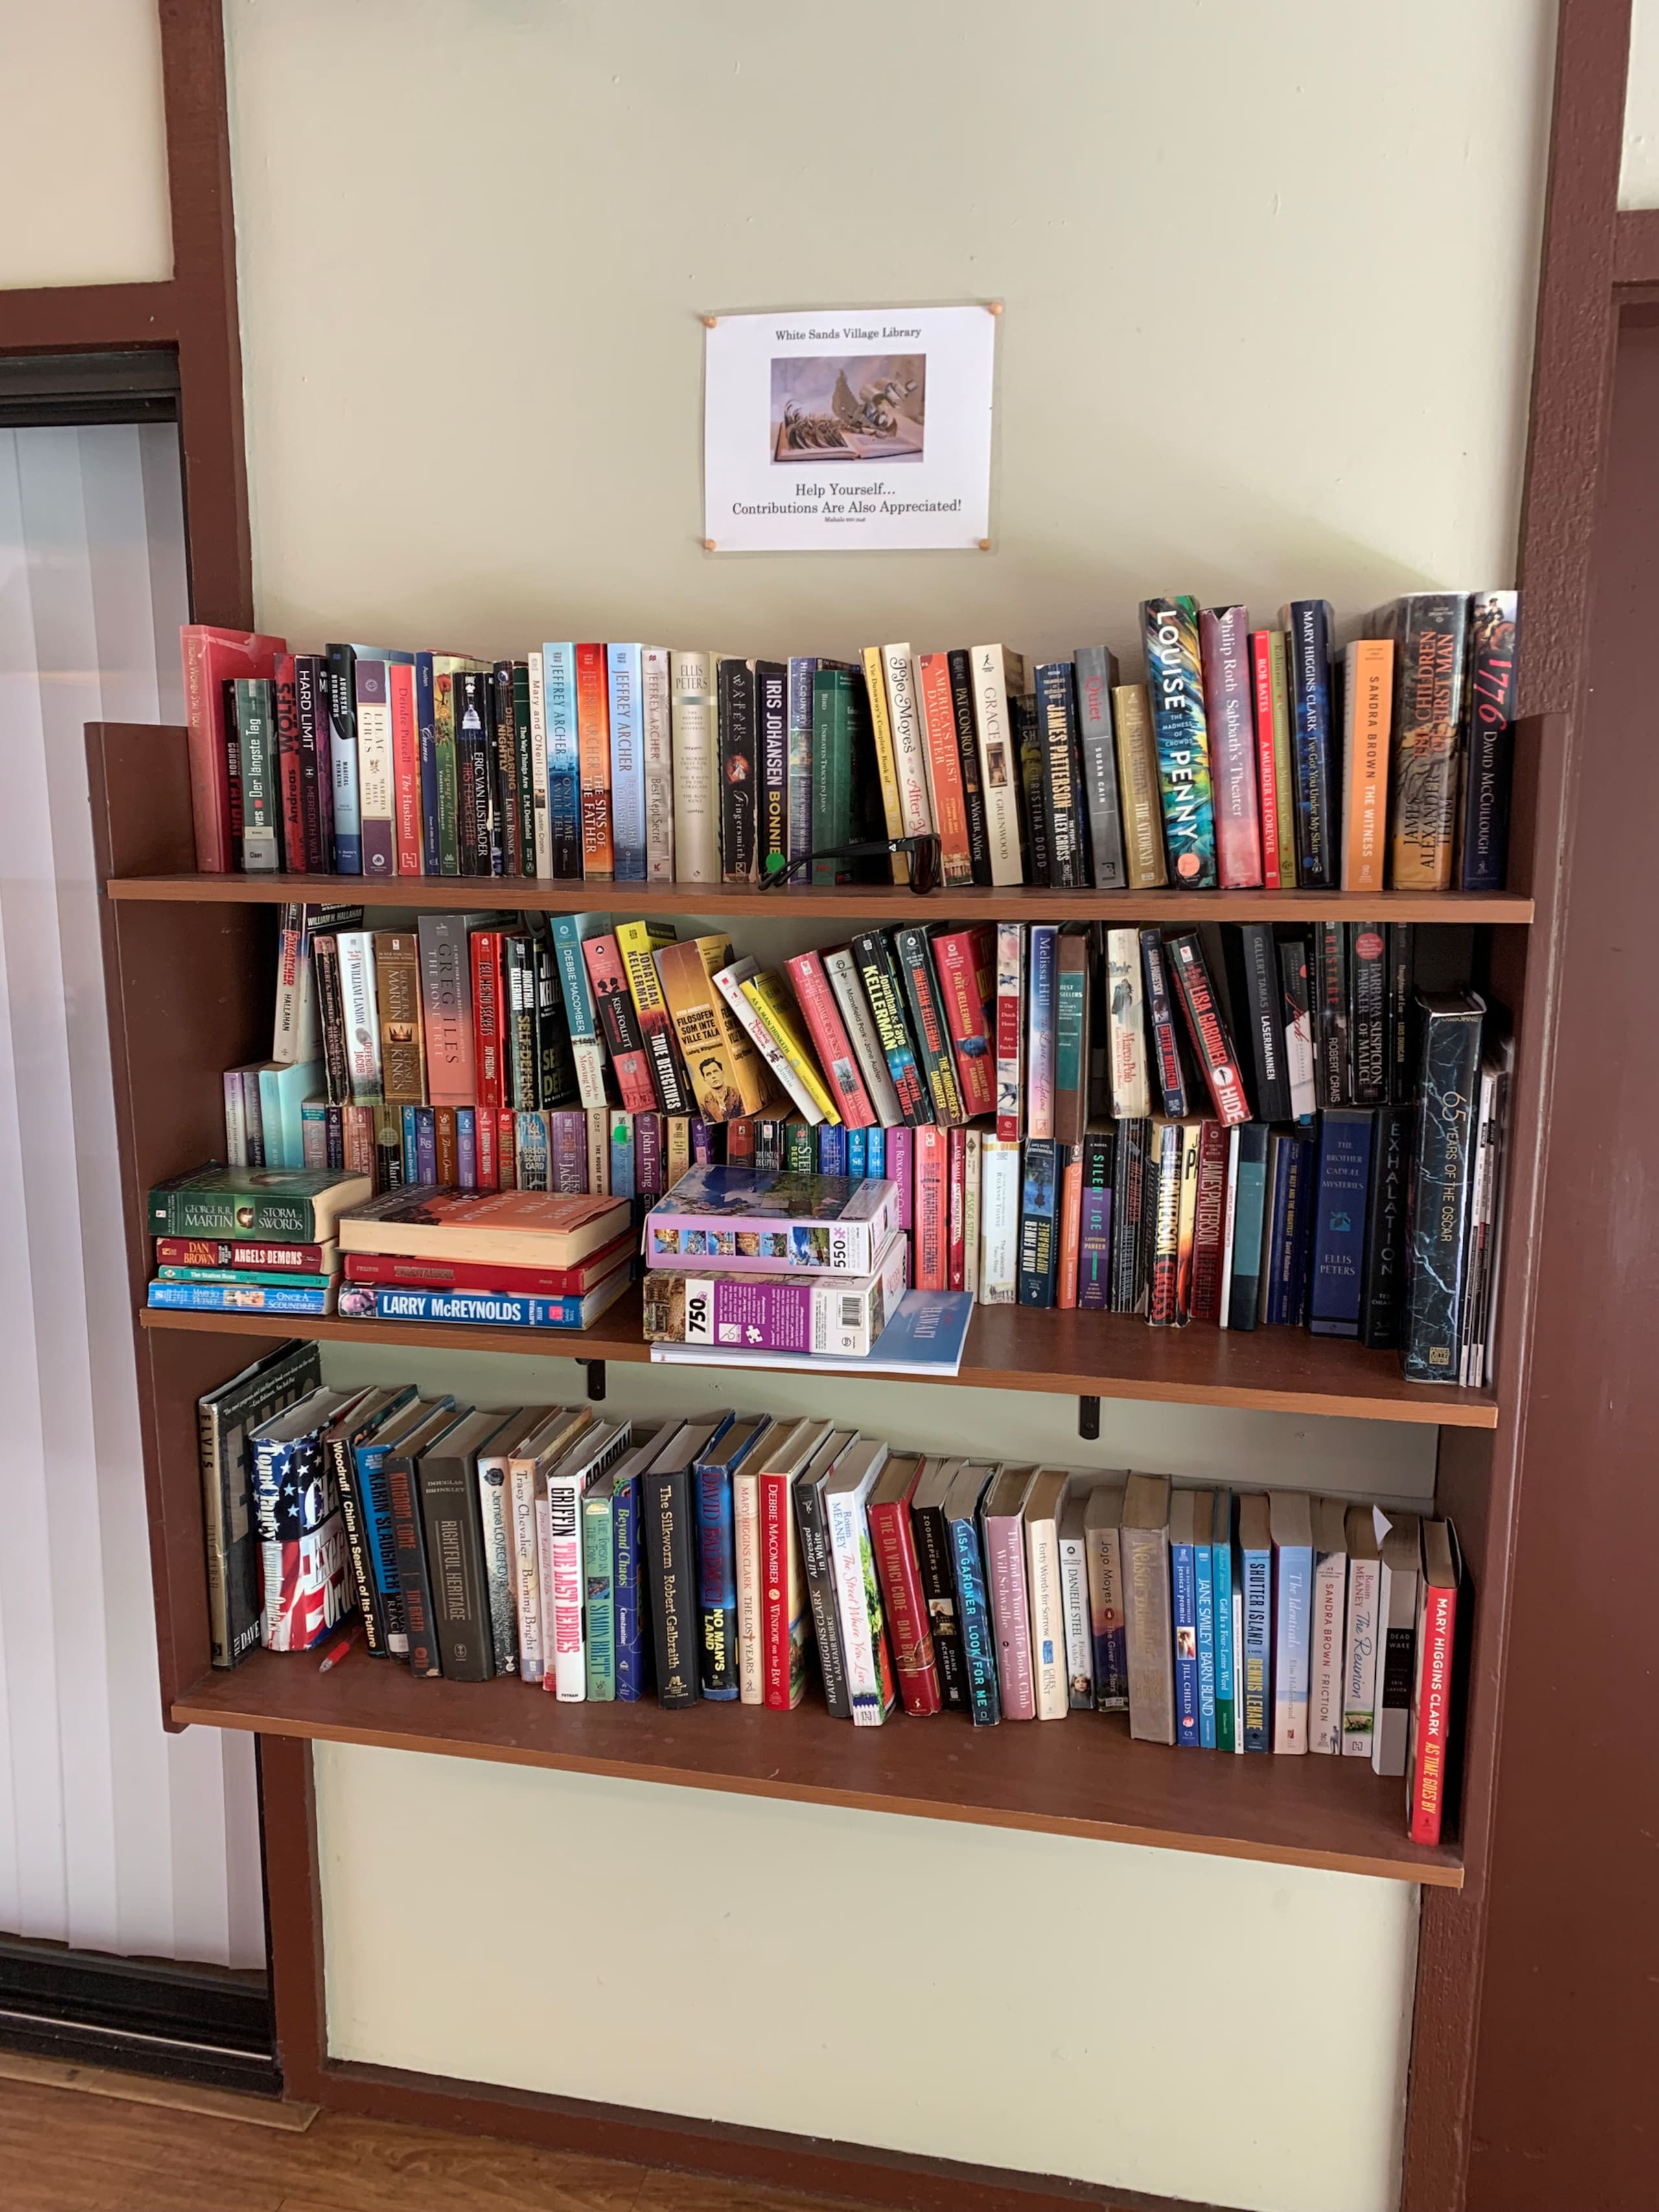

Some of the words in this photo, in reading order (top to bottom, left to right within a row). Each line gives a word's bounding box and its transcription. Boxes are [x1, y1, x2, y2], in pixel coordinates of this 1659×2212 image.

[776, 330, 806, 341] White
[809, 329, 840, 340] Sands
[842, 329, 879, 339] Village
[882, 327, 921, 339] Library
[732, 502, 818, 515] Contributions
[822, 502, 844, 513] Are
[849, 501, 876, 513] Also
[880, 499, 962, 513] Appreciated!
[796, 483, 825, 498] Help
[830, 482, 895, 496] Yourself...
[1303, 611, 1314, 643] MARY
[1156, 611, 1185, 710] LOUISE
[1257, 658, 1268, 680] ROB
[1305, 646, 1315, 692] HIGGINS
[299, 670, 311, 710] HARD
[532, 681, 540, 705] Mary
[552, 664, 564, 708] JEFFREY
[767, 680, 782, 708] IRIS
[1086, 676, 1102, 721] Quiet
[1259, 683, 1269, 712] BATES
[1368, 677, 1380, 727] SANDRA
[1474, 658, 1513, 730] 1776
[927, 690, 944, 764] DAUGHTER
[935, 667, 953, 741] AMERICA'S
[945, 745, 957, 784] FIRST
[984, 687, 1000, 741] GRACE
[1047, 704, 1065, 742] JAMES
[1225, 699, 1241, 761] Sabbath's
[1306, 694, 1317, 732] CLARK
[301, 714, 314, 751] LIMIT
[364, 712, 373, 753] GIRLS
[374, 714, 384, 752] LILAC
[554, 712, 566, 755] ARCHER
[767, 712, 782, 786] JOHANSEN
[1482, 731, 1498, 767] DAVID
[474, 752, 484, 775] ERIC
[1262, 751, 1273, 795] MURDER
[1366, 734, 1377, 778] BROWN
[401, 774, 411, 791] The
[476, 776, 485, 797] VAN
[583, 776, 593, 798] THE
[594, 773, 604, 795] THE
[651, 778, 661, 796] Best
[1050, 745, 1071, 808] PATTERSON
[1170, 751, 1198, 839] PENNY
[1231, 764, 1243, 817] Theater
[1364, 786, 1376, 804] THE
[403, 795, 413, 839] Husband
[595, 799, 606, 828] SINS
[650, 798, 661, 817] Kept
[1264, 797, 1273, 806] IS
[477, 800, 487, 856] LUSTBADER
[585, 803, 596, 853] FATHER
[596, 832, 606, 846] OF
[653, 819, 661, 843] Secret
[769, 791, 780, 854] BONNIE
[1054, 813, 1067, 833] ALEX
[1265, 809, 1275, 854] FOREVER
[1363, 809, 1374, 857] WITNESS
[1055, 835, 1069, 861] CROSS
[439, 944, 454, 1005] GREG
[1039, 937, 1050, 980] Melissa
[511, 968, 522, 1010] KELLERMAN
[523, 970, 534, 1008] JONATHAN
[563, 949, 576, 980] DEBBIE
[570, 982, 585, 1032] MACOMBER
[627, 951, 649, 1011] KELLERMAN
[638, 952, 660, 1006] JONATHAN
[1039, 983, 1050, 1006] Hill
[1189, 984, 1211, 1011] LISA
[283, 994, 292, 1031] HALLAHAN
[863, 965, 897, 1050] KELLERMAN
[879, 973, 896, 1015] Jonathan
[893, 1023, 906, 1045] Faye
[443, 1018, 459, 1064] ILES
[651, 1033, 666, 1058] TRUE
[1197, 1012, 1228, 1066] GARDNER
[1260, 1016, 1275, 1080] LASERMANNEN
[938, 1056, 949, 1071] THE
[656, 1059, 681, 1109] DETECTIVES
[931, 1071, 946, 1109] DAUGHTER
[943, 1071, 959, 1118] MURDERER'S
[1219, 1087, 1244, 1123] HIDE
[1445, 1126, 1459, 1160] YEARS
[1092, 1155, 1104, 1201] SILENT
[1445, 1164, 1456, 1179] OF
[1443, 1182, 1456, 1202] THE
[1091, 1209, 1102, 1229] JOE
[1441, 1206, 1455, 1242] OSCAR
[184, 1253, 215, 1263] BROWN
[189, 1243, 209, 1252] DAN
[235, 1249, 265, 1263] ANGELS
[267, 1251, 302, 1264] DEMONS
[833, 1240, 846, 1268] 550
[383, 1296, 424, 1316] LARRY
[432, 1299, 521, 1321] McREYNOLDS
[688, 1298, 706, 1333] 750
[332, 1442, 350, 1491] Woodruff
[551, 1487, 575, 1537] GRIFFIN
[660, 1485, 671, 1509] The
[768, 1484, 778, 1520] DEBBIE
[343, 1501, 357, 1531] China
[349, 1534, 358, 1544] in
[441, 1520, 461, 1570] RIGHTFUL
[553, 1543, 575, 1568] THE
[662, 1511, 673, 1568] Silkworm
[769, 1524, 779, 1583] MACOMBER
[957, 1525, 970, 1552] LISA
[351, 1546, 365, 1583] Search
[359, 1586, 368, 1596] of
[446, 1572, 465, 1620] HERITAGE
[554, 1570, 578, 1602] LAST
[664, 1576, 675, 1614] Robert
[961, 1557, 976, 1616] GARDNER
[1068, 1568, 1080, 1611] DANIELLE
[1198, 1578, 1212, 1606] JANE
[1248, 1563, 1265, 1606] SHUTTER
[1355, 1566, 1364, 1608] MEANEY
[362, 1598, 371, 1611] Its
[713, 1609, 723, 1629] NO
[1325, 1584, 1333, 1625] SANDRA
[1353, 1612, 1371, 1634] The
[1435, 1598, 1447, 1635] MARY
[363, 1614, 377, 1647] Future
[555, 1606, 580, 1653] HEROES
[665, 1616, 679, 1670] Galbraith
[704, 1615, 714, 1650] LAND
[968, 1625, 980, 1656] LOOK
[1071, 1613, 1082, 1637] STEEL
[1200, 1607, 1212, 1646] SMILEY
[1247, 1610, 1263, 1646] ISLAND
[714, 1631, 725, 1671] MAN'S
[1323, 1629, 1332, 1667] BROWN
[1432, 1638, 1444, 1690] HIGGINS
[973, 1662, 984, 1684] FOR
[1201, 1652, 1214, 1683] BARN
[1247, 1659, 1262, 1691] DENNIS
[1351, 1637, 1372, 1698] Reunion
[977, 1690, 987, 1706] ME
[1182, 1682, 1192, 1714] CHILDS
[1202, 1685, 1214, 1716] BLIND
[1247, 1695, 1263, 1730] LEHANE
[1320, 1674, 1330, 1721] FRICTION
[1428, 1694, 1441, 1736] CLARK
[1423, 1756, 1438, 1776] TIME
[1426, 1742, 1439, 1755] AS
[1421, 1800, 1435, 1813] BY
[1422, 1778, 1436, 1799] GOES
